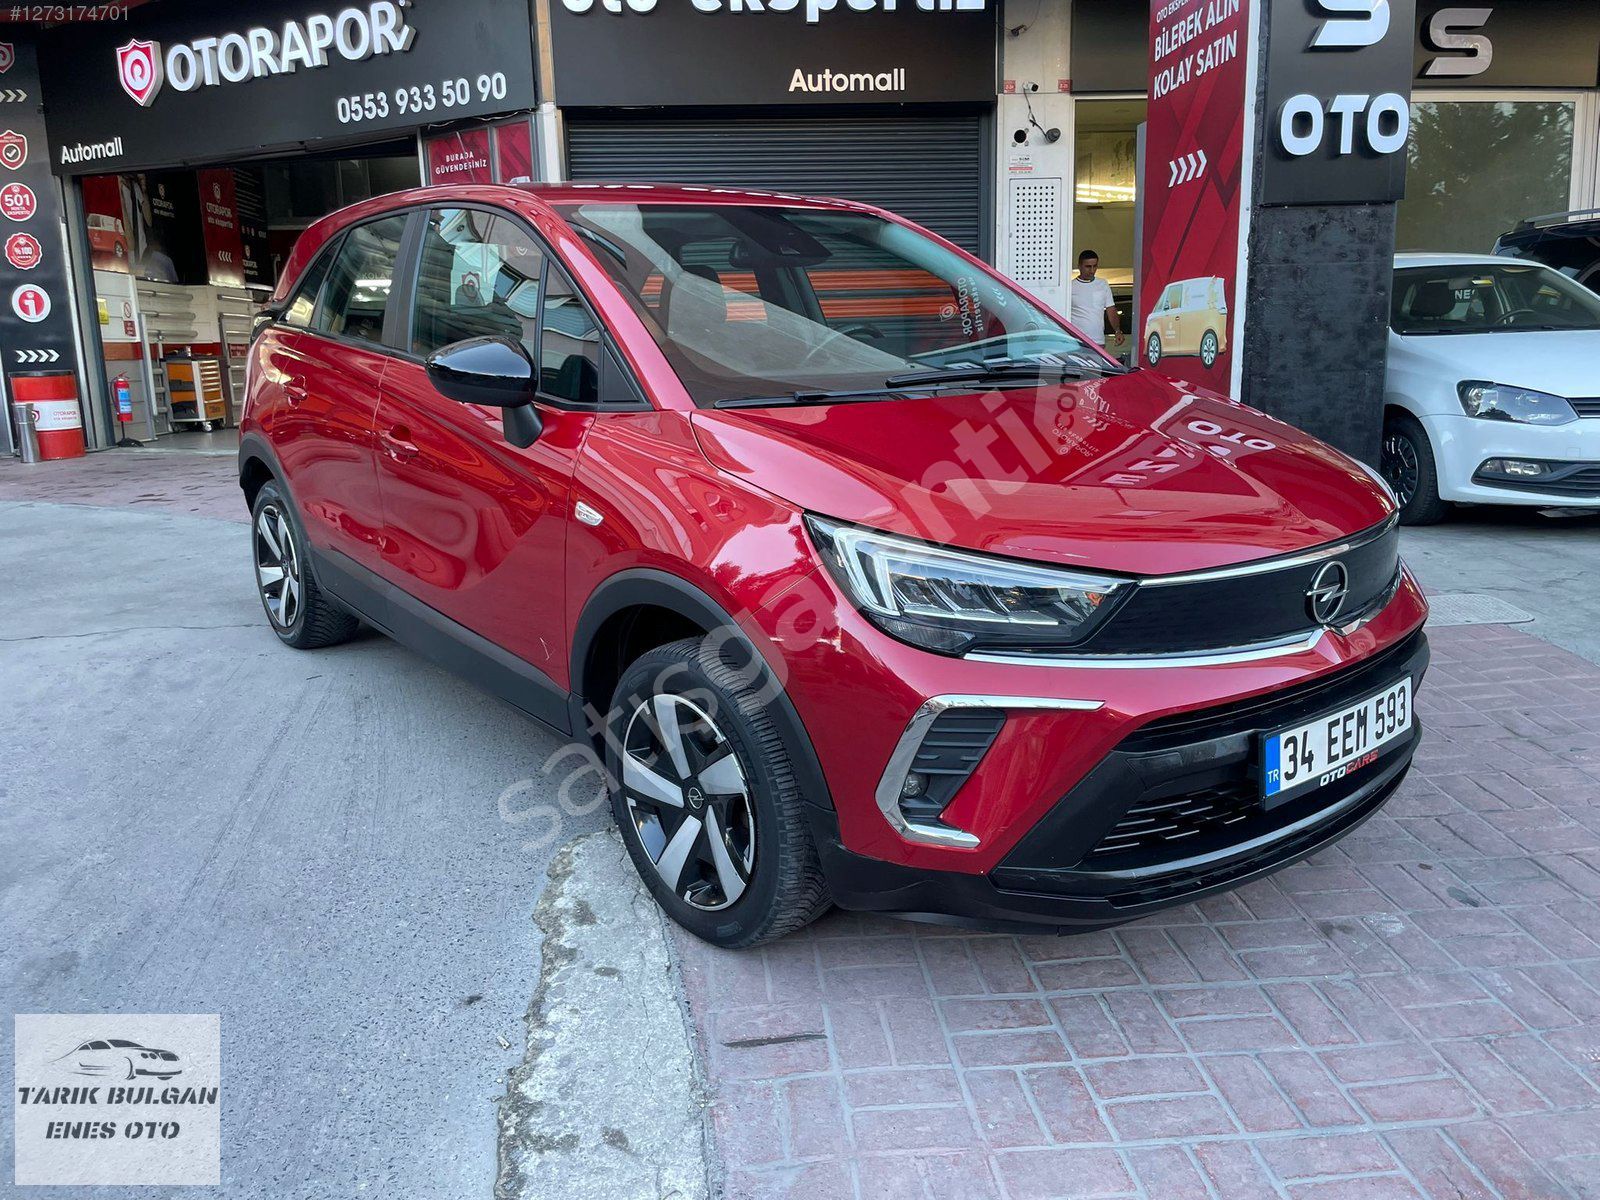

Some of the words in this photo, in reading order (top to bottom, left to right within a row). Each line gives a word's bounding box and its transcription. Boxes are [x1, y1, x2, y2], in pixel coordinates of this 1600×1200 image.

[167, 2, 410, 92] OTORAPOR
[1154, 7, 1203, 62] BİLEREK
[1205, 0, 1239, 31] ALIN
[788, 68, 905, 92] Automall
[1153, 55, 1193, 100] KOLAY
[1196, 30, 1237, 77] SATIN
[337, 91, 389, 124] 0553
[395, 84, 436, 114] 933
[442, 78, 470, 107] 50
[477, 72, 507, 102] 90
[1279, 92, 1410, 156] OTO
[61, 136, 123, 164] Automall
[435, 158, 487, 175] GÜVENDESİNİZ
[445, 151, 474, 163] BURADA
[4, 194, 30, 207] 501
[1454, 288, 1476, 299] NE
[1267, 769, 1279, 784] TR
[1283, 730, 1314, 781] 34
[1327, 705, 1368, 765] EEM
[1375, 685, 1406, 740] 593
[1319, 749, 1379, 787] OTOCARS
